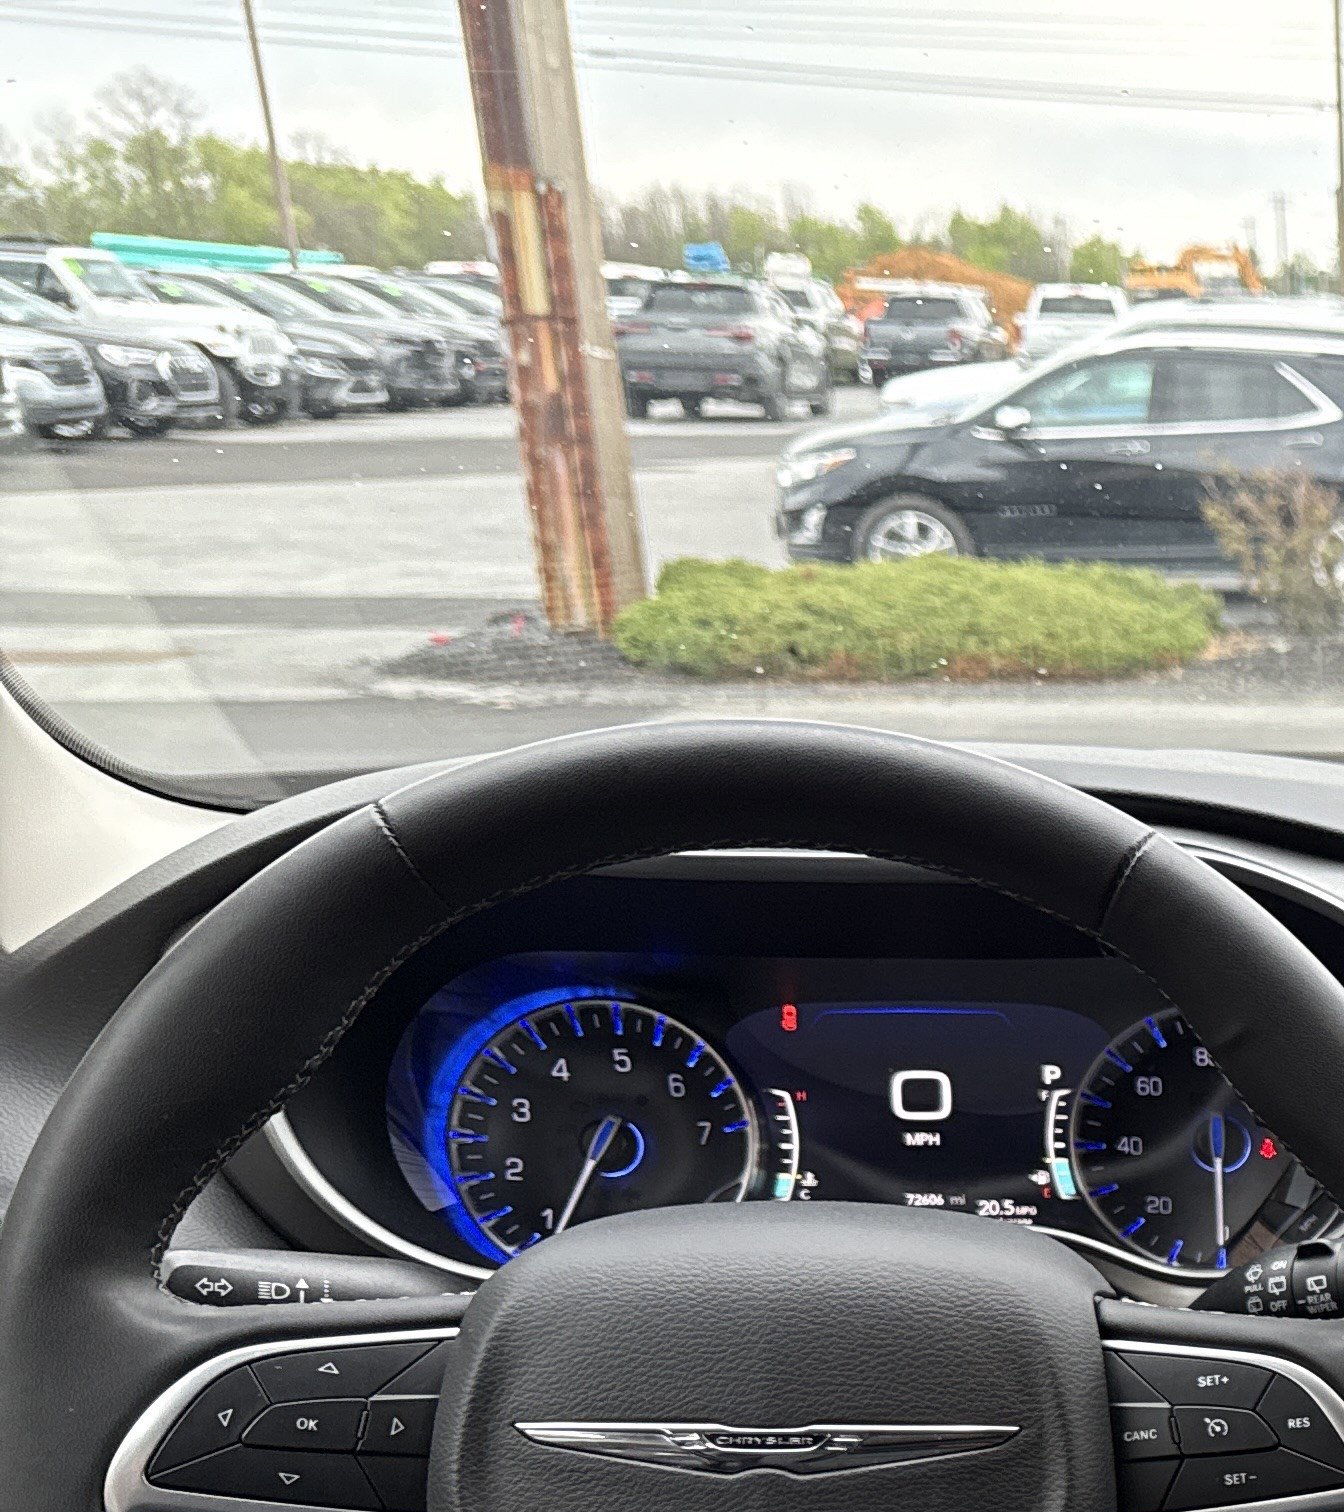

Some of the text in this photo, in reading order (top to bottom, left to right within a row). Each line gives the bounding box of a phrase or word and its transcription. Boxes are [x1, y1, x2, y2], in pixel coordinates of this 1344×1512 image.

[550, 1058, 571, 1082] 4
[612, 1049, 632, 1073] 5
[1041, 1064, 1061, 1084] P
[667, 1073, 686, 1098] 6
[1136, 1077, 1163, 1097] 60
[797, 1092, 807, 1101] H
[890, 1069, 952, 1121] 0
[511, 1098, 531, 1123] 3
[696, 1121, 713, 1145] 7
[904, 1133, 941, 1147] MPH
[1117, 1137, 1143, 1156] 40
[504, 1157, 524, 1182] 2
[800, 1190, 811, 1200] C
[902, 1192, 944, 1206] 72606
[976, 1199, 1014, 1216] 20.5
[1146, 1196, 1173, 1215] 20
[541, 1208, 554, 1229] 1
[1306, 1292, 1331, 1305] REAR
[1306, 1300, 1339, 1314] WIPER
[1197, 1375, 1230, 1387] SET+
[296, 1417, 318, 1431] OK
[1287, 1417, 1311, 1429] RES
[716, 1436, 814, 1446] CHRYSLER
[1124, 1429, 1158, 1442] CANC
